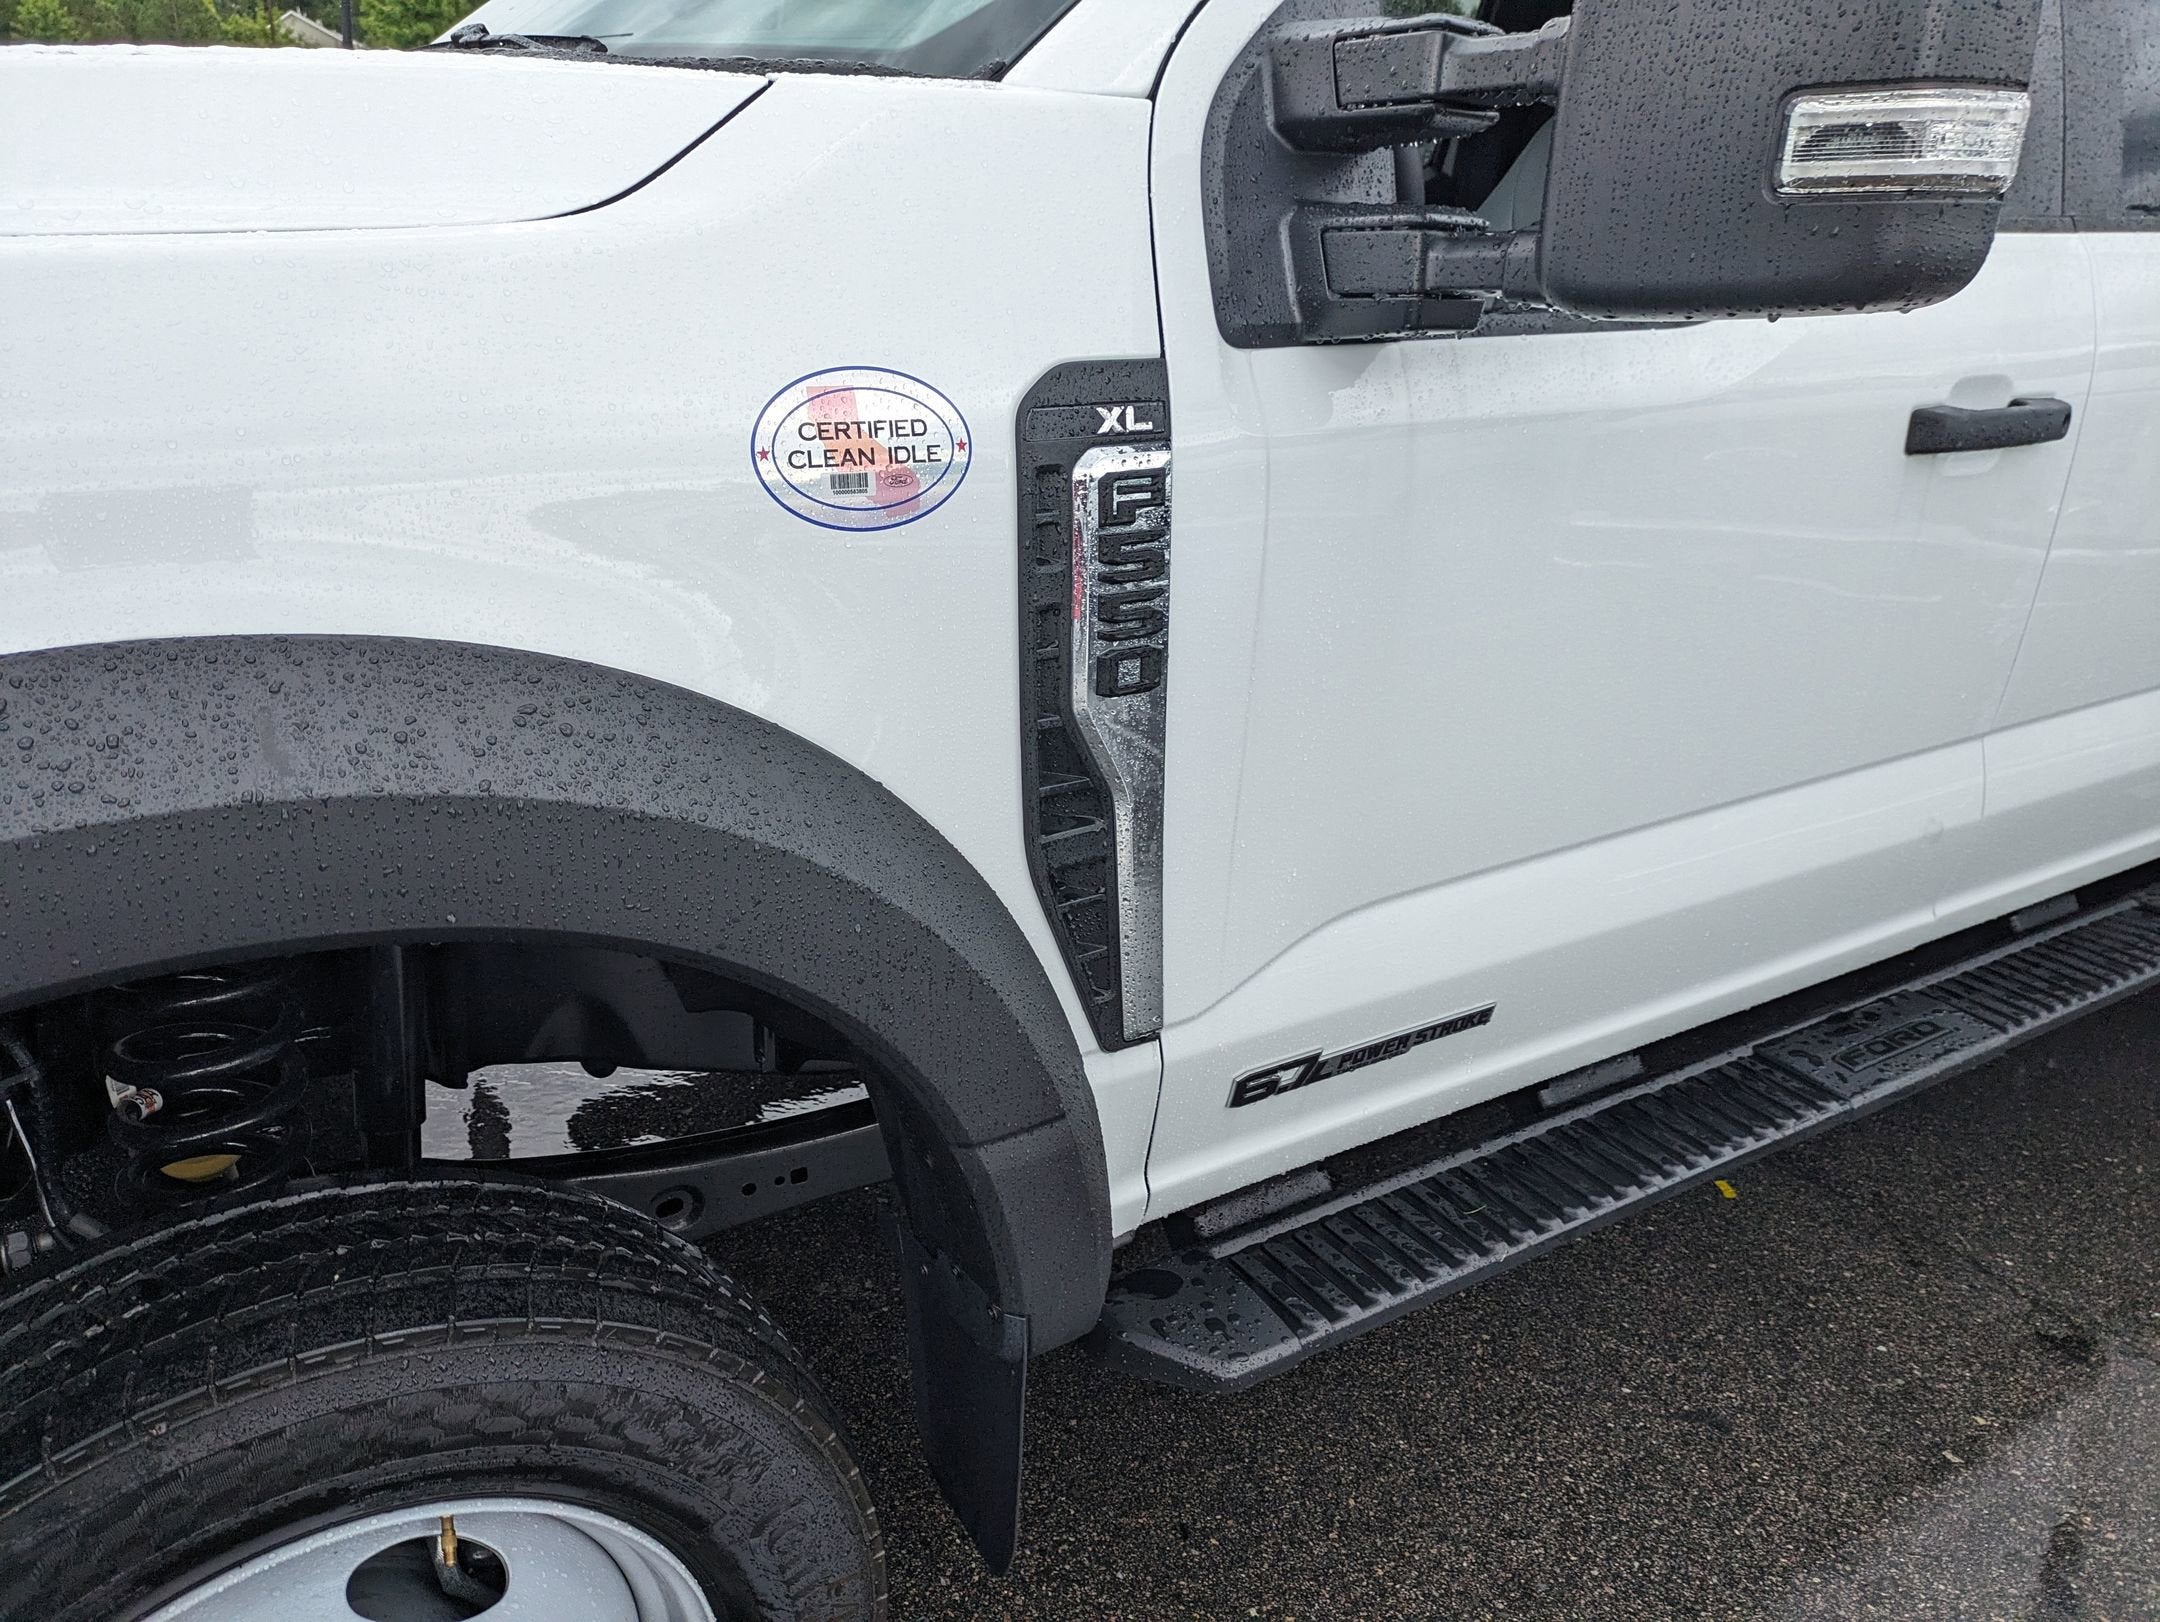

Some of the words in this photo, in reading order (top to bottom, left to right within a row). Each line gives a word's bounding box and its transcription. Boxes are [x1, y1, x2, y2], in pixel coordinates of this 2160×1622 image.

[798, 418, 928, 442] CERTIFIED
[1096, 405, 1153, 434] XL
[788, 447, 876, 470] CLEAN
[887, 444, 942, 465] IDLE
[887, 474, 911, 486] Ford
[1335, 1034, 1411, 1069] POWER
[1412, 1010, 1493, 1046] STROKE
[1837, 1021, 1947, 1066] FORD
